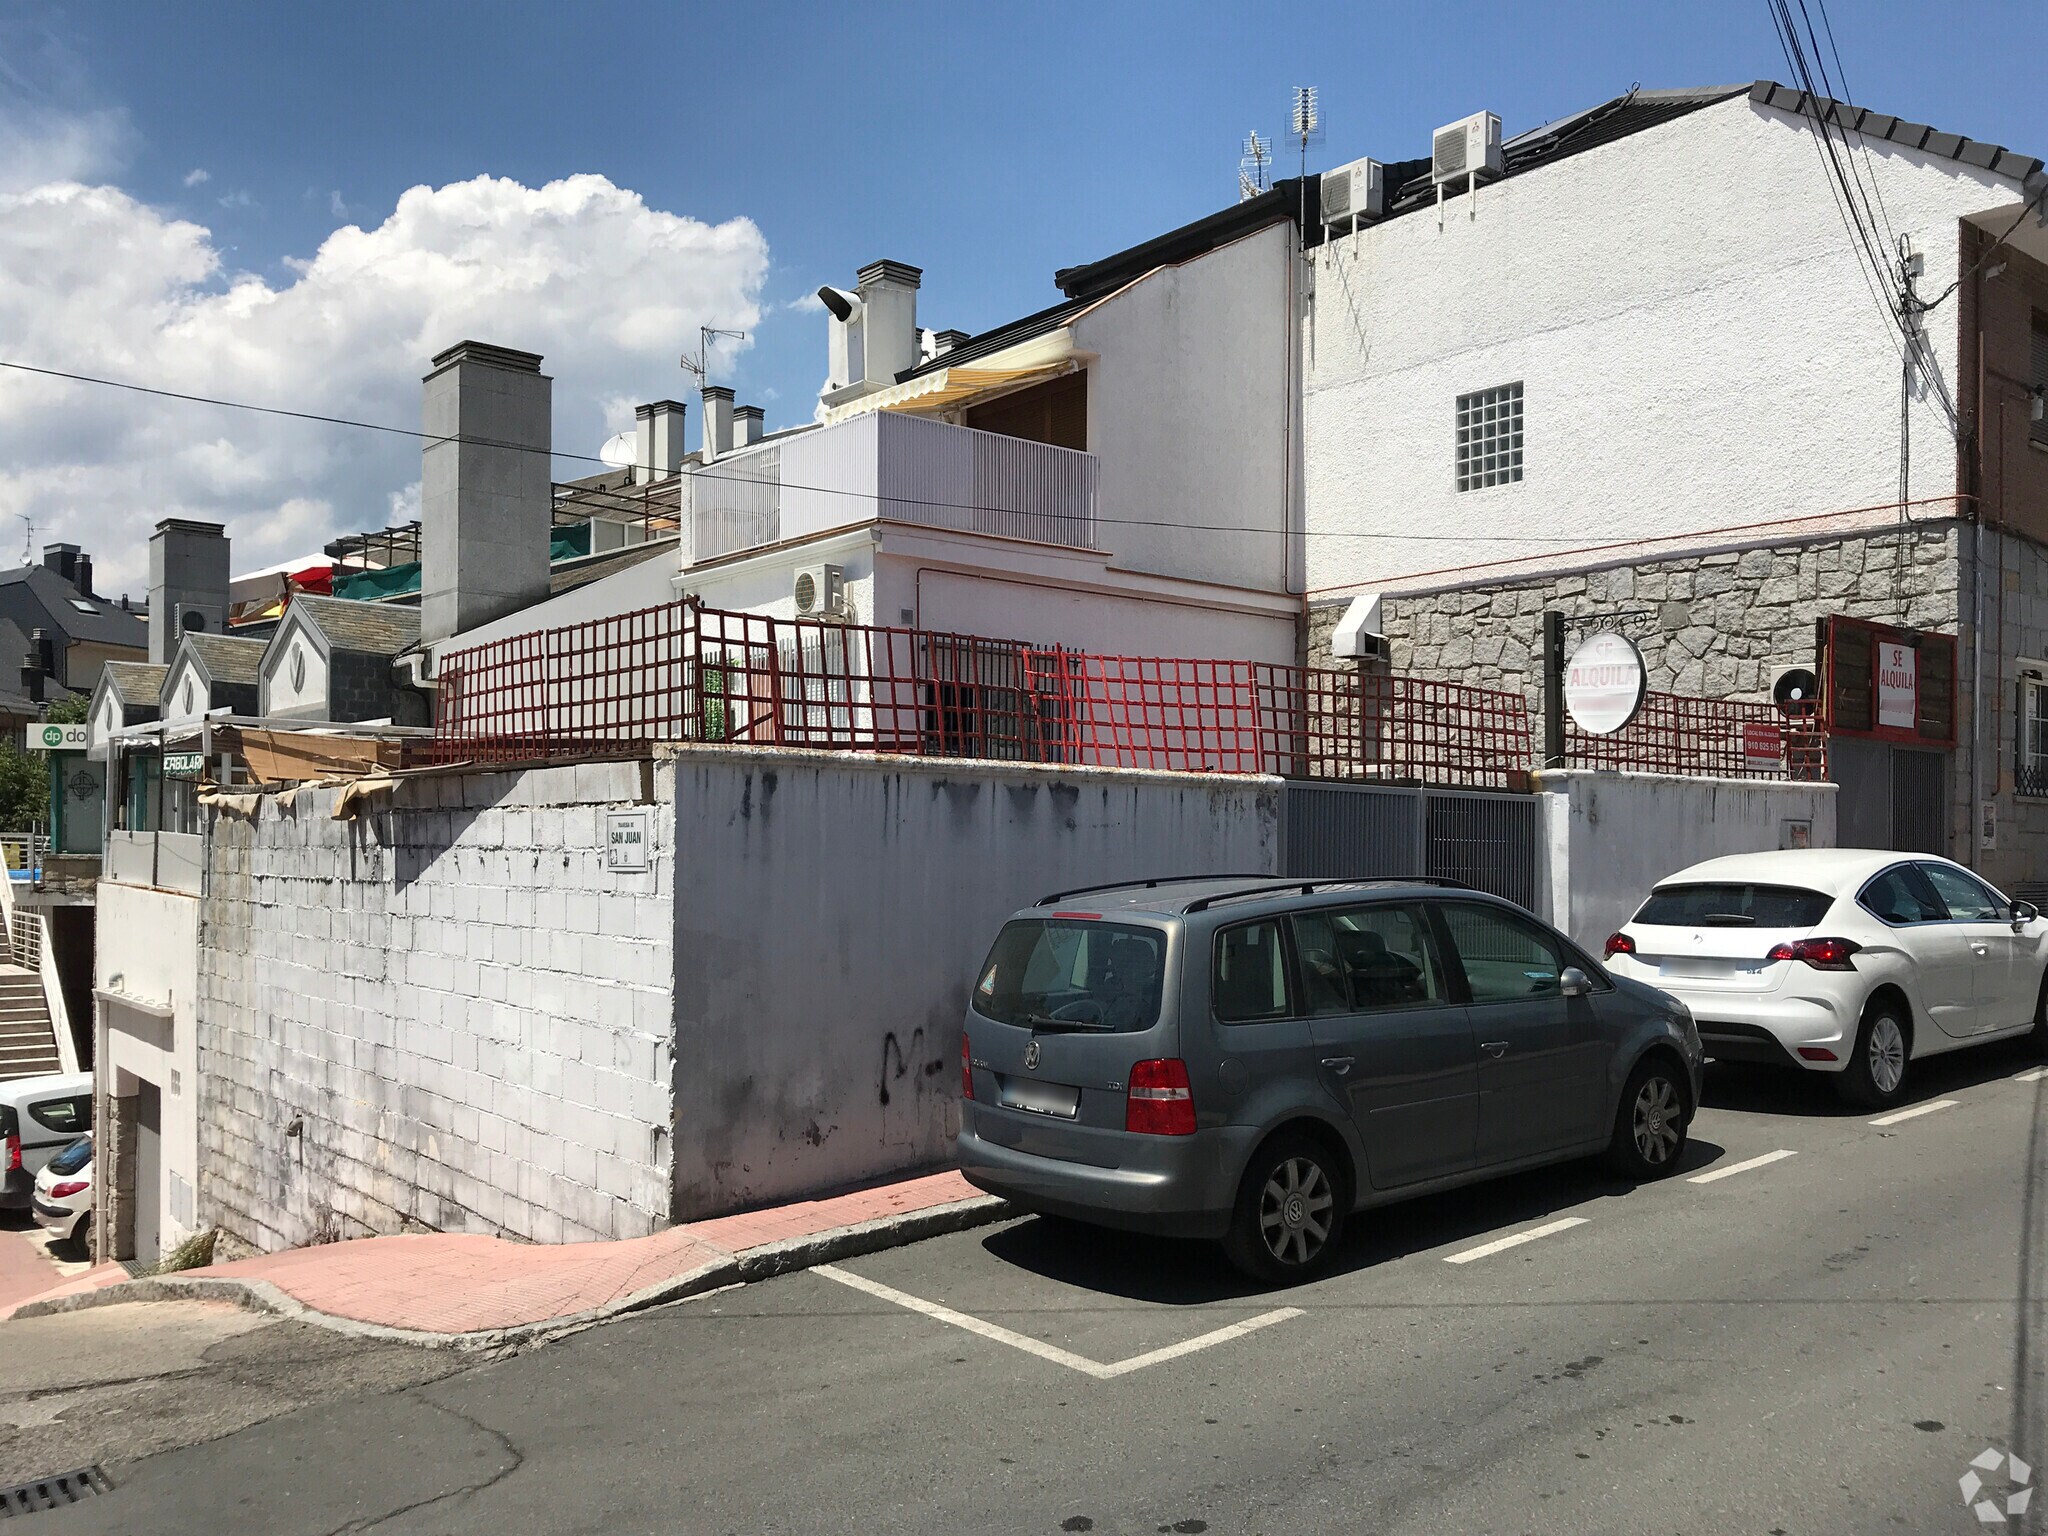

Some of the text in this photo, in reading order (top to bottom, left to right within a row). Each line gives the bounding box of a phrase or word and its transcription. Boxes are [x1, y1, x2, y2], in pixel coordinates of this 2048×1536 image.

[1893, 650, 1903, 667] SE
[1570, 665, 1635, 688] ALQUILA
[1881, 669, 1913, 690] ALQUILA
[611, 831, 642, 844] SAN JUAN
